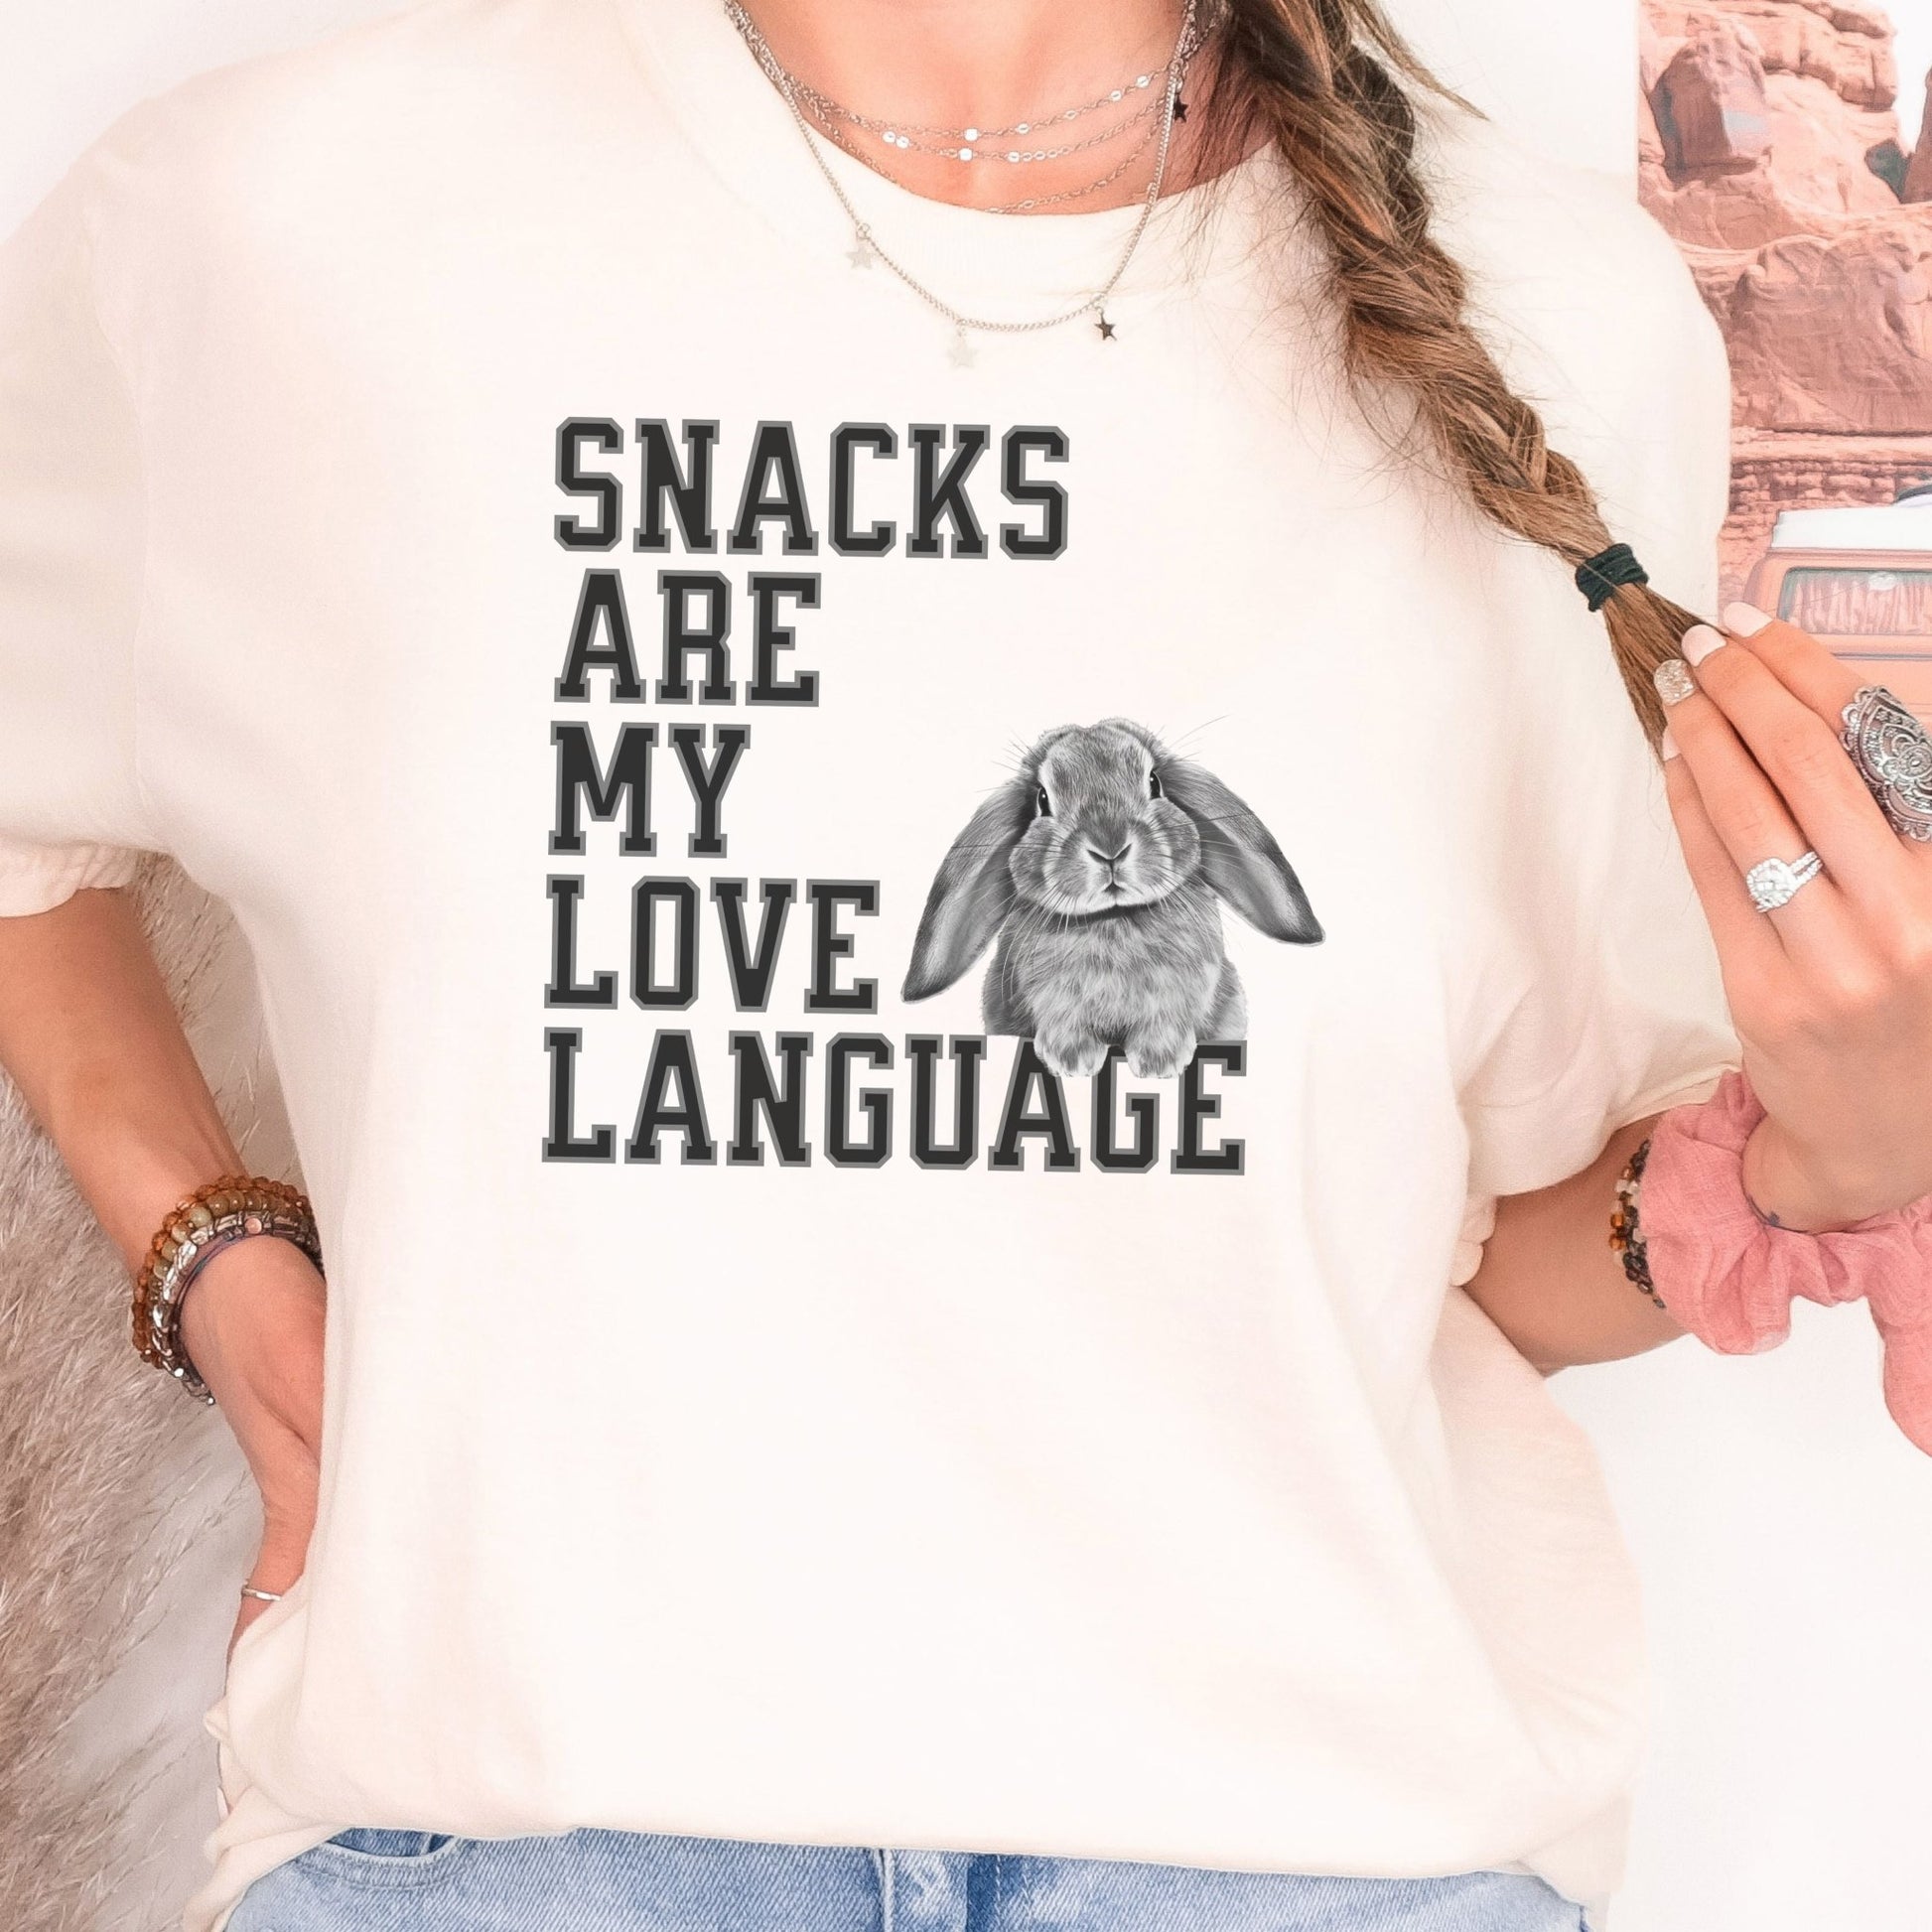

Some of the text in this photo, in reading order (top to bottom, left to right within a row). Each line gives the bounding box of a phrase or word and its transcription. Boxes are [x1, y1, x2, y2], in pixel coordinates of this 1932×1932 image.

[554, 416, 1069, 561] SNACKS
[554, 568, 822, 708] ARE
[548, 720, 752, 859] MY
[544, 874, 881, 1015] LOVE
[542, 1027, 1248, 1175] LANGUAGE
